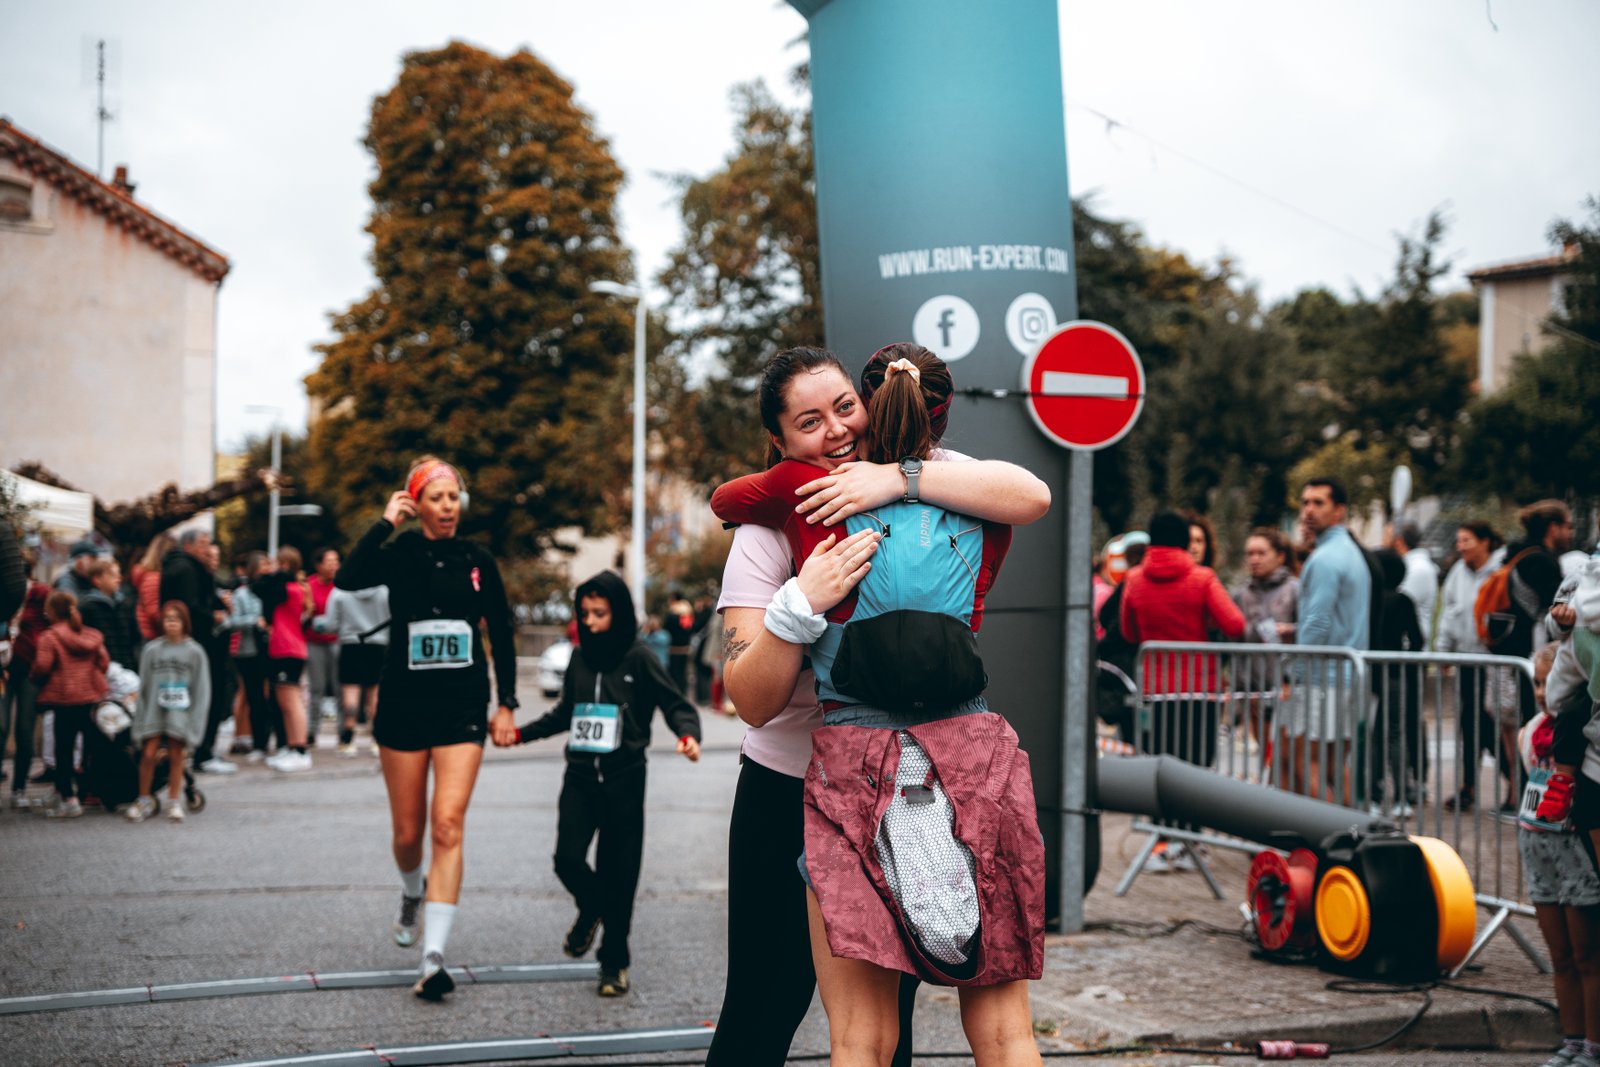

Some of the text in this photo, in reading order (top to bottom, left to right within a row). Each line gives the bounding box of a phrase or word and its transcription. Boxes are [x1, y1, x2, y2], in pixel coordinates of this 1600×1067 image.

[919, 508, 931, 548] KIPRUN
[421, 633, 459, 657] 676
[575, 720, 604, 740] 520
